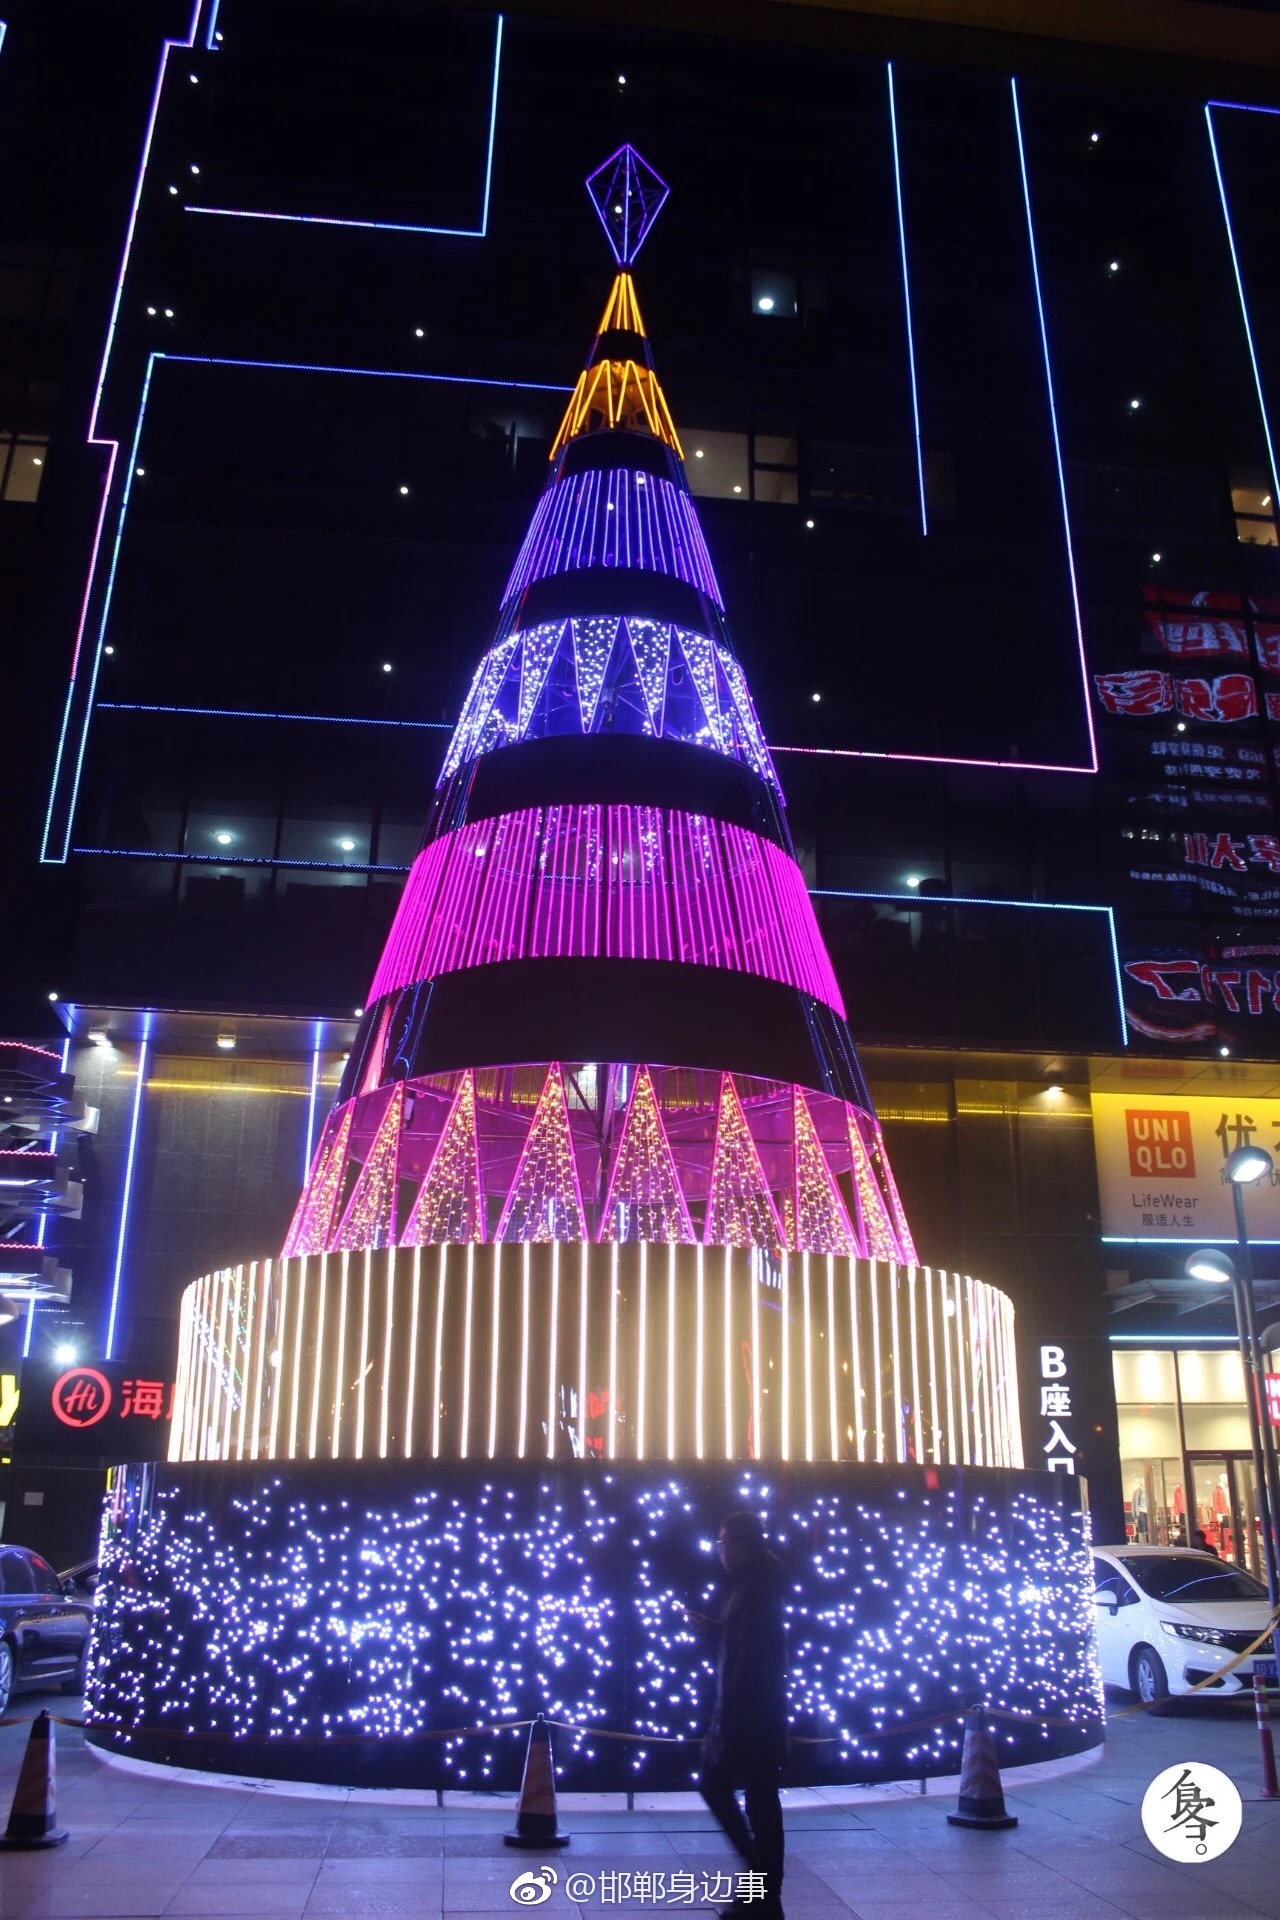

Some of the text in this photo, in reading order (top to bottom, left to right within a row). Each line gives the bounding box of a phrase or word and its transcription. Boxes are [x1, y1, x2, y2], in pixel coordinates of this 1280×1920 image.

[1133, 1117, 1181, 1142] UNI
[1214, 1112, 1280, 1160] 优
[1136, 1145, 1188, 1173] QLO
[1131, 1192, 1200, 1209] LifeWear
[1141, 1212, 1196, 1228] 服适人生
[63, 1379, 98, 1414] Hi
[119, 1379, 177, 1421] 海
